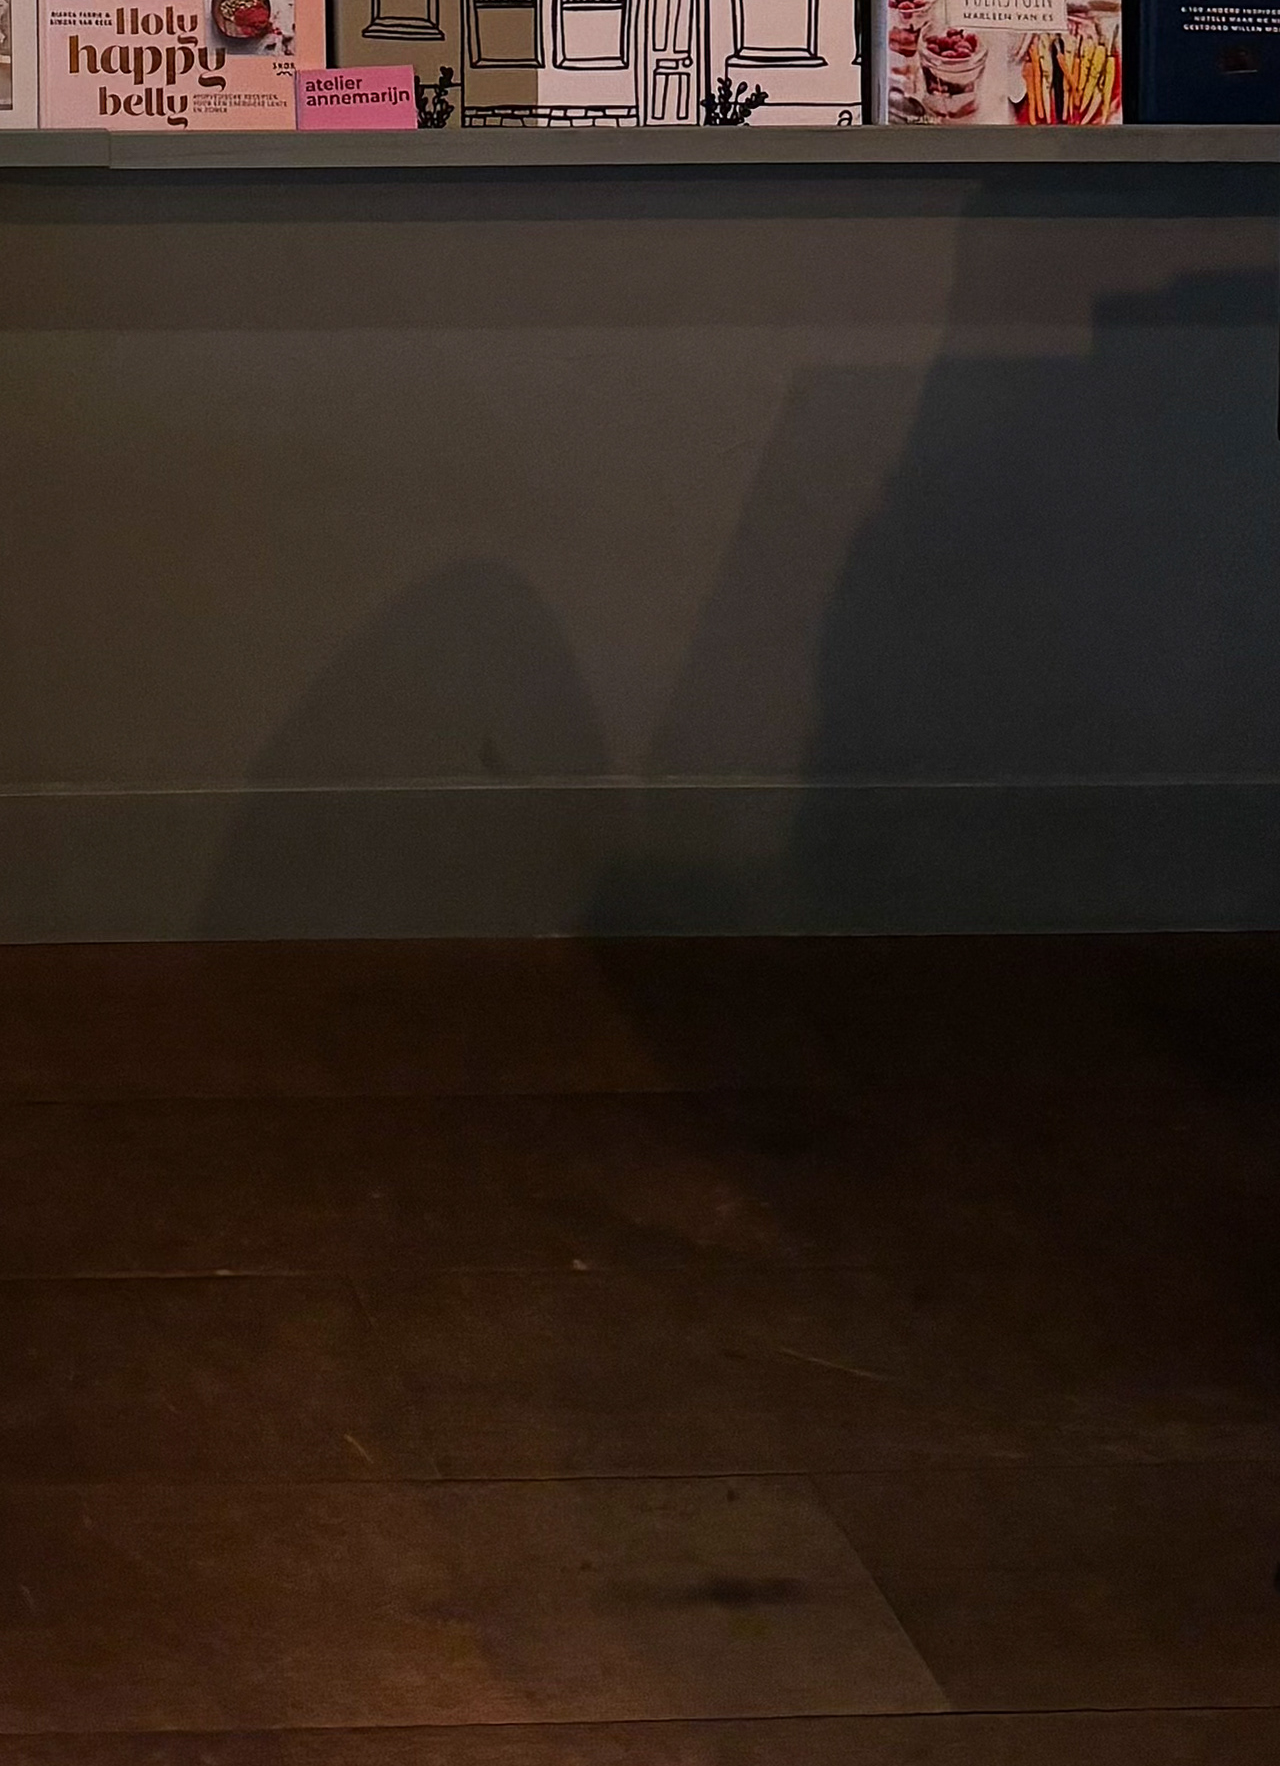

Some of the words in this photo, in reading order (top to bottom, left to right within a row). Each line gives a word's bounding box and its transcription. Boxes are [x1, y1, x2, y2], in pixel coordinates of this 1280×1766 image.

[115, 6, 199, 48] Holy
[1017, 12, 1038, 21] VAN
[1042, 12, 1054, 22] ES
[68, 34, 228, 92] happy
[304, 74, 364, 93] atelier
[305, 86, 411, 108] annemarijn
[98, 86, 189, 129] belly
